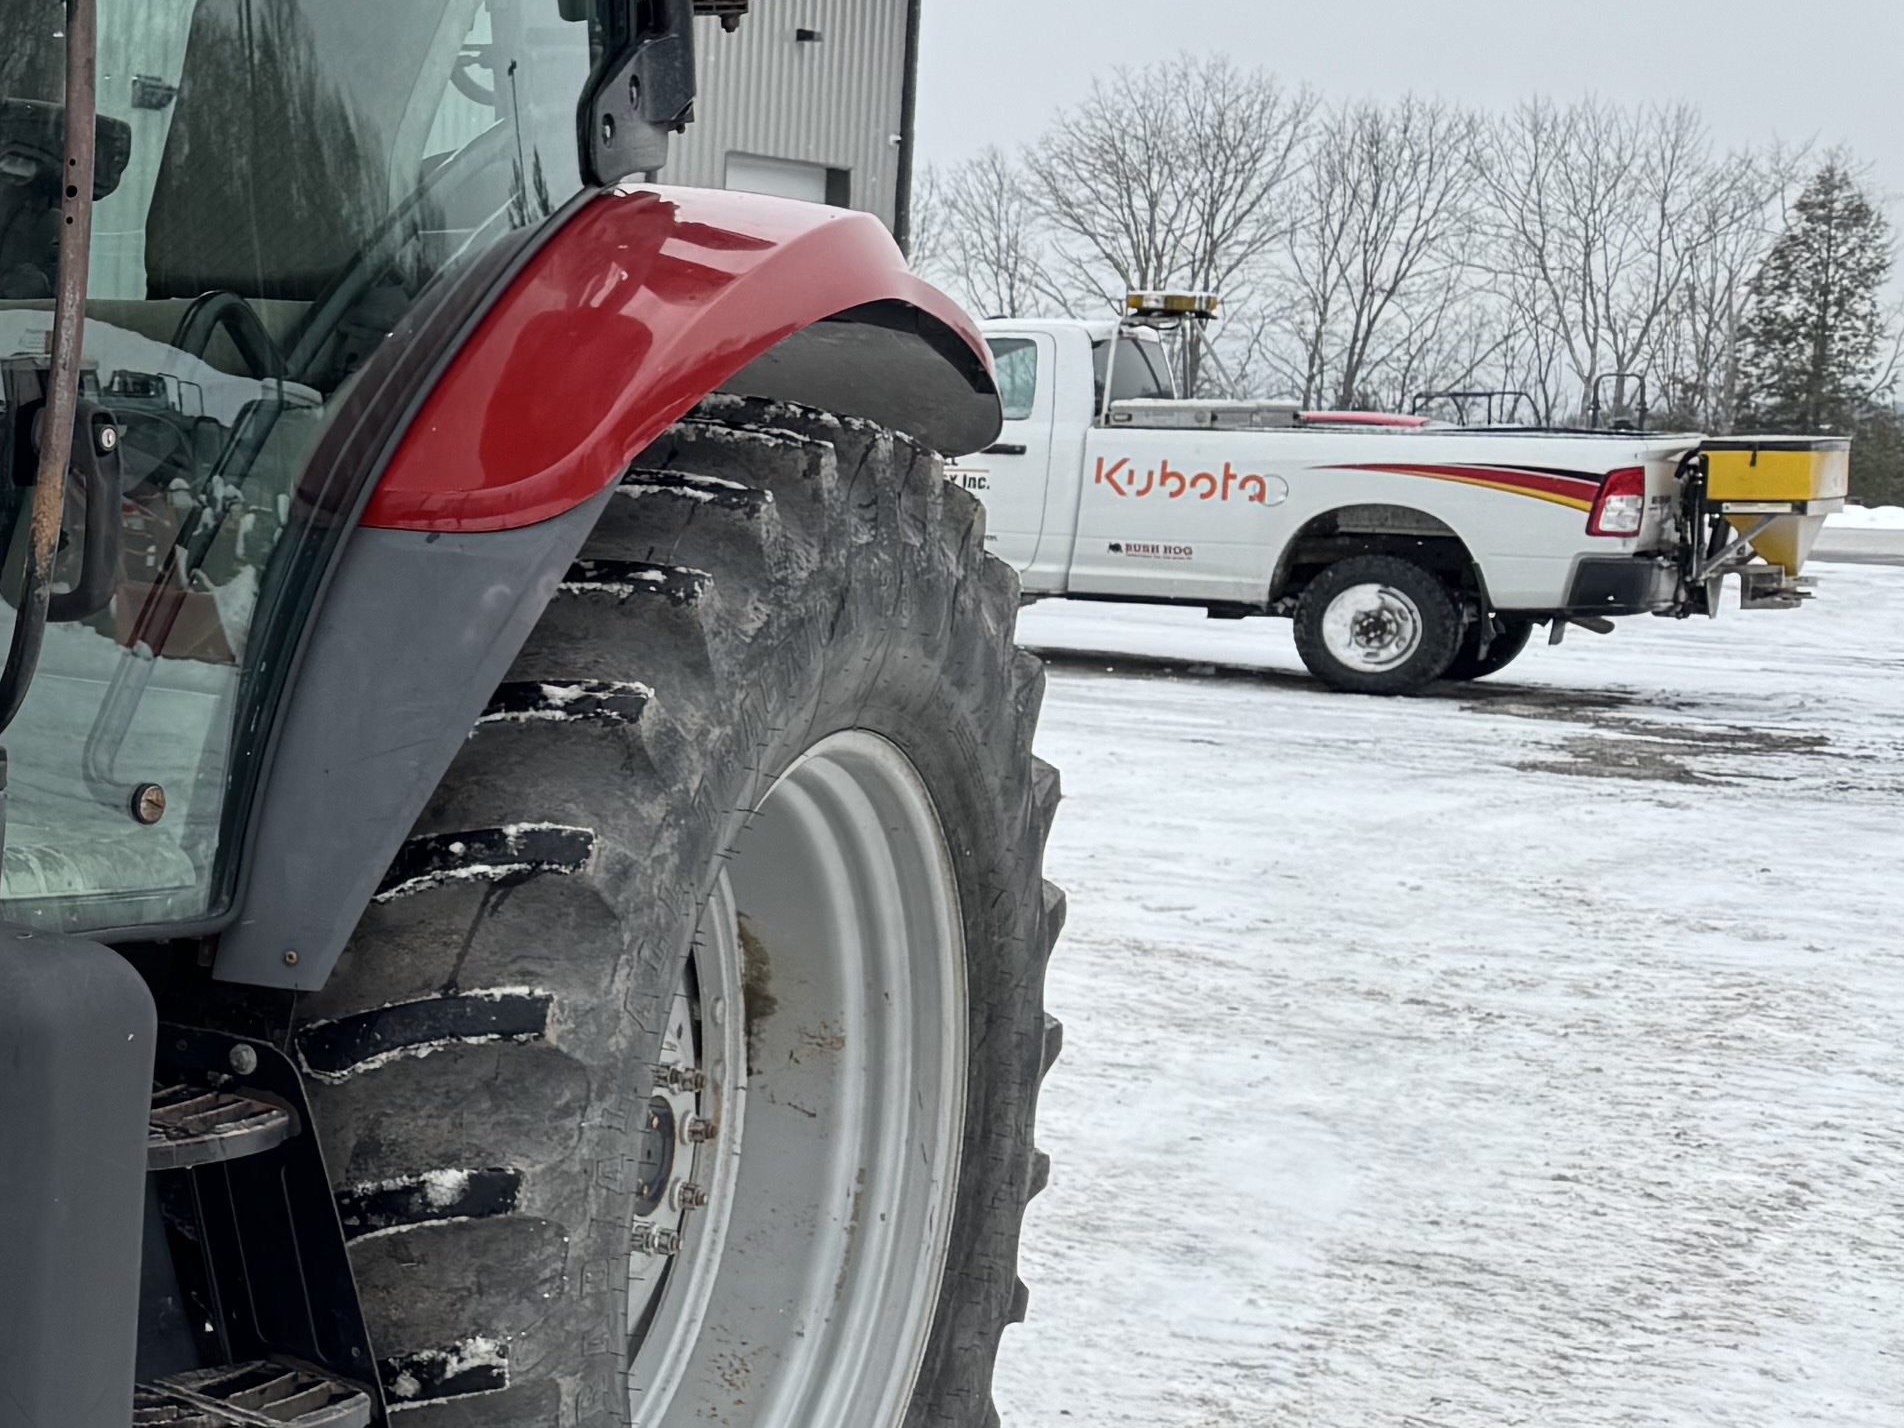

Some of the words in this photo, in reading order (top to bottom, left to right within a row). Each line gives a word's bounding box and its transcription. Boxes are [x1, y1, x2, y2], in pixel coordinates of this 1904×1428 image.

[963, 474, 990, 490] Inc.
[1095, 457, 1267, 503] Kubota
[1125, 542, 1159, 554] BUSH
[1163, 544, 1193, 556] HOG
